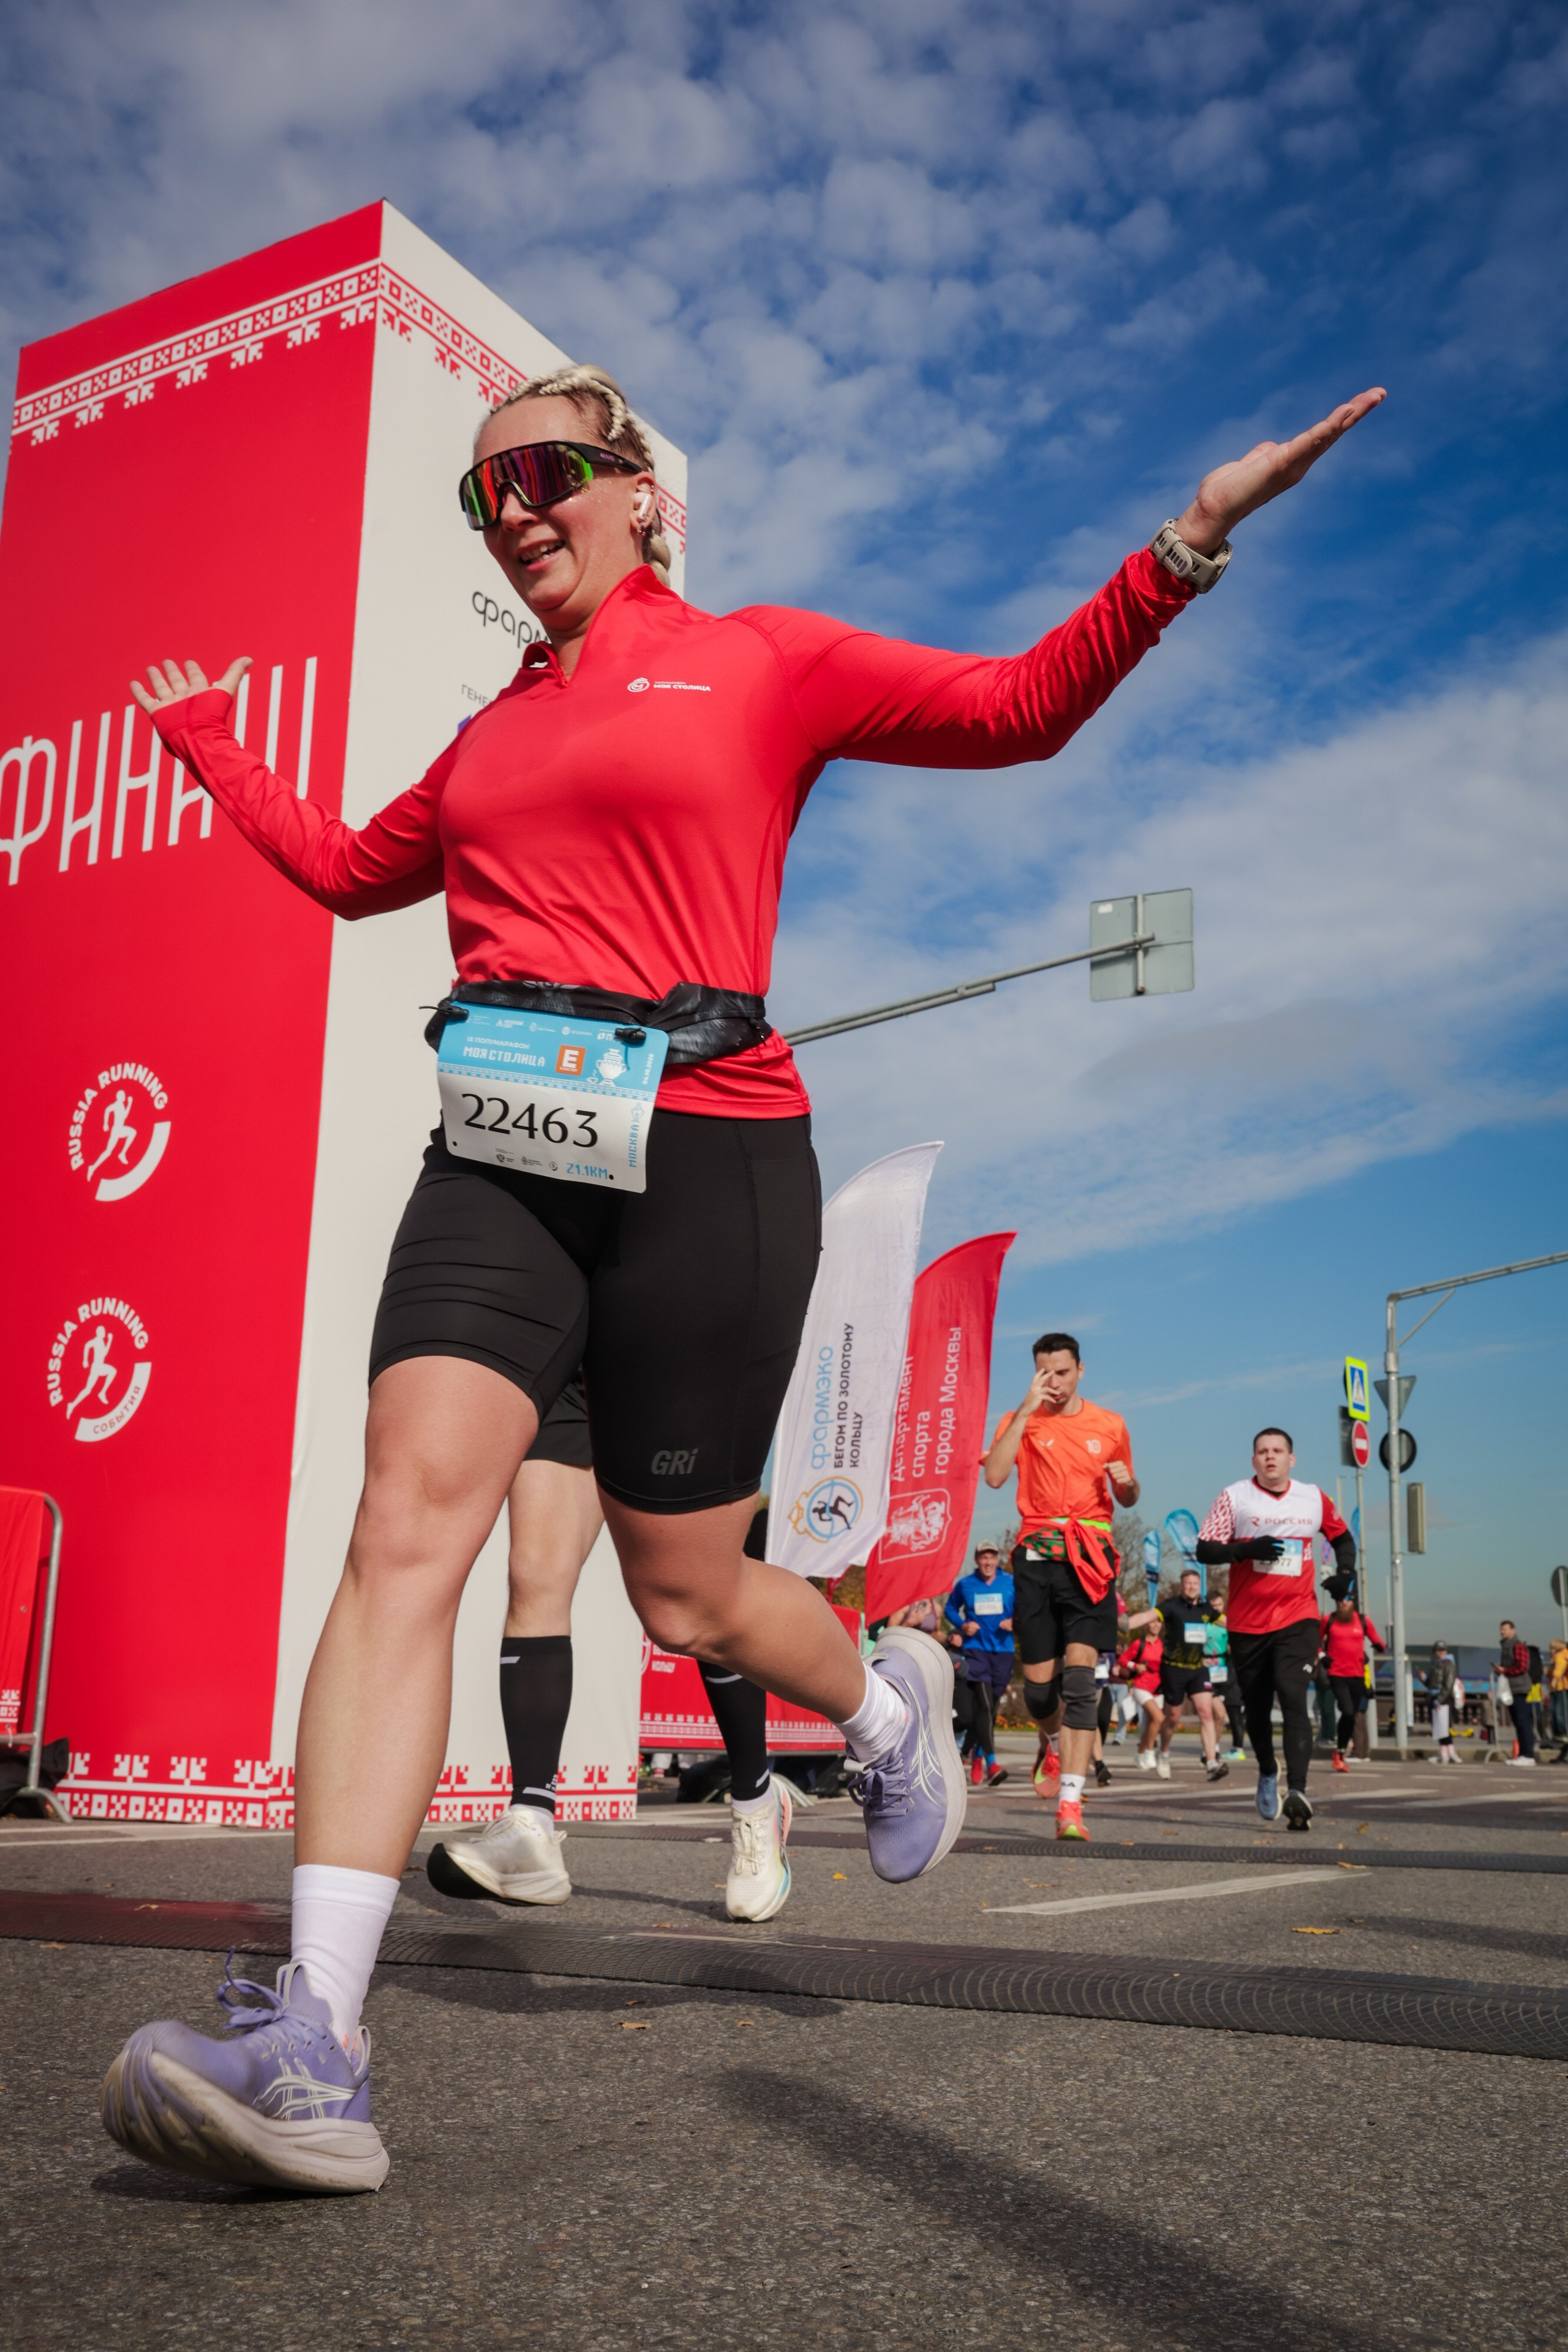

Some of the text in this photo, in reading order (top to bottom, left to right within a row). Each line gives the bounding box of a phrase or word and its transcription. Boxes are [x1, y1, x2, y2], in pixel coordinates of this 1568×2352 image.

[461, 684, 492, 707] ГЕНЕ
[463, 1046, 546, 1067] МОЯ СТОЛИЦА
[69, 1062, 168, 1170] RUSSIA RUNNING
[462, 1093, 598, 1148] 22463
[628, 1125, 639, 1168] МОСКВА
[47, 1297, 148, 1407] RUSSIA RUNNING
[93, 1385, 140, 1434] СОБЫТИЯ
[834, 1323, 853, 1469] БЕГОМ ПО ЗОЛОТОМУ
[935, 1327, 962, 1474] города Москвы
[850, 1412, 863, 1468] КОЛЬЦУ
[912, 1411, 933, 1478] спорта
